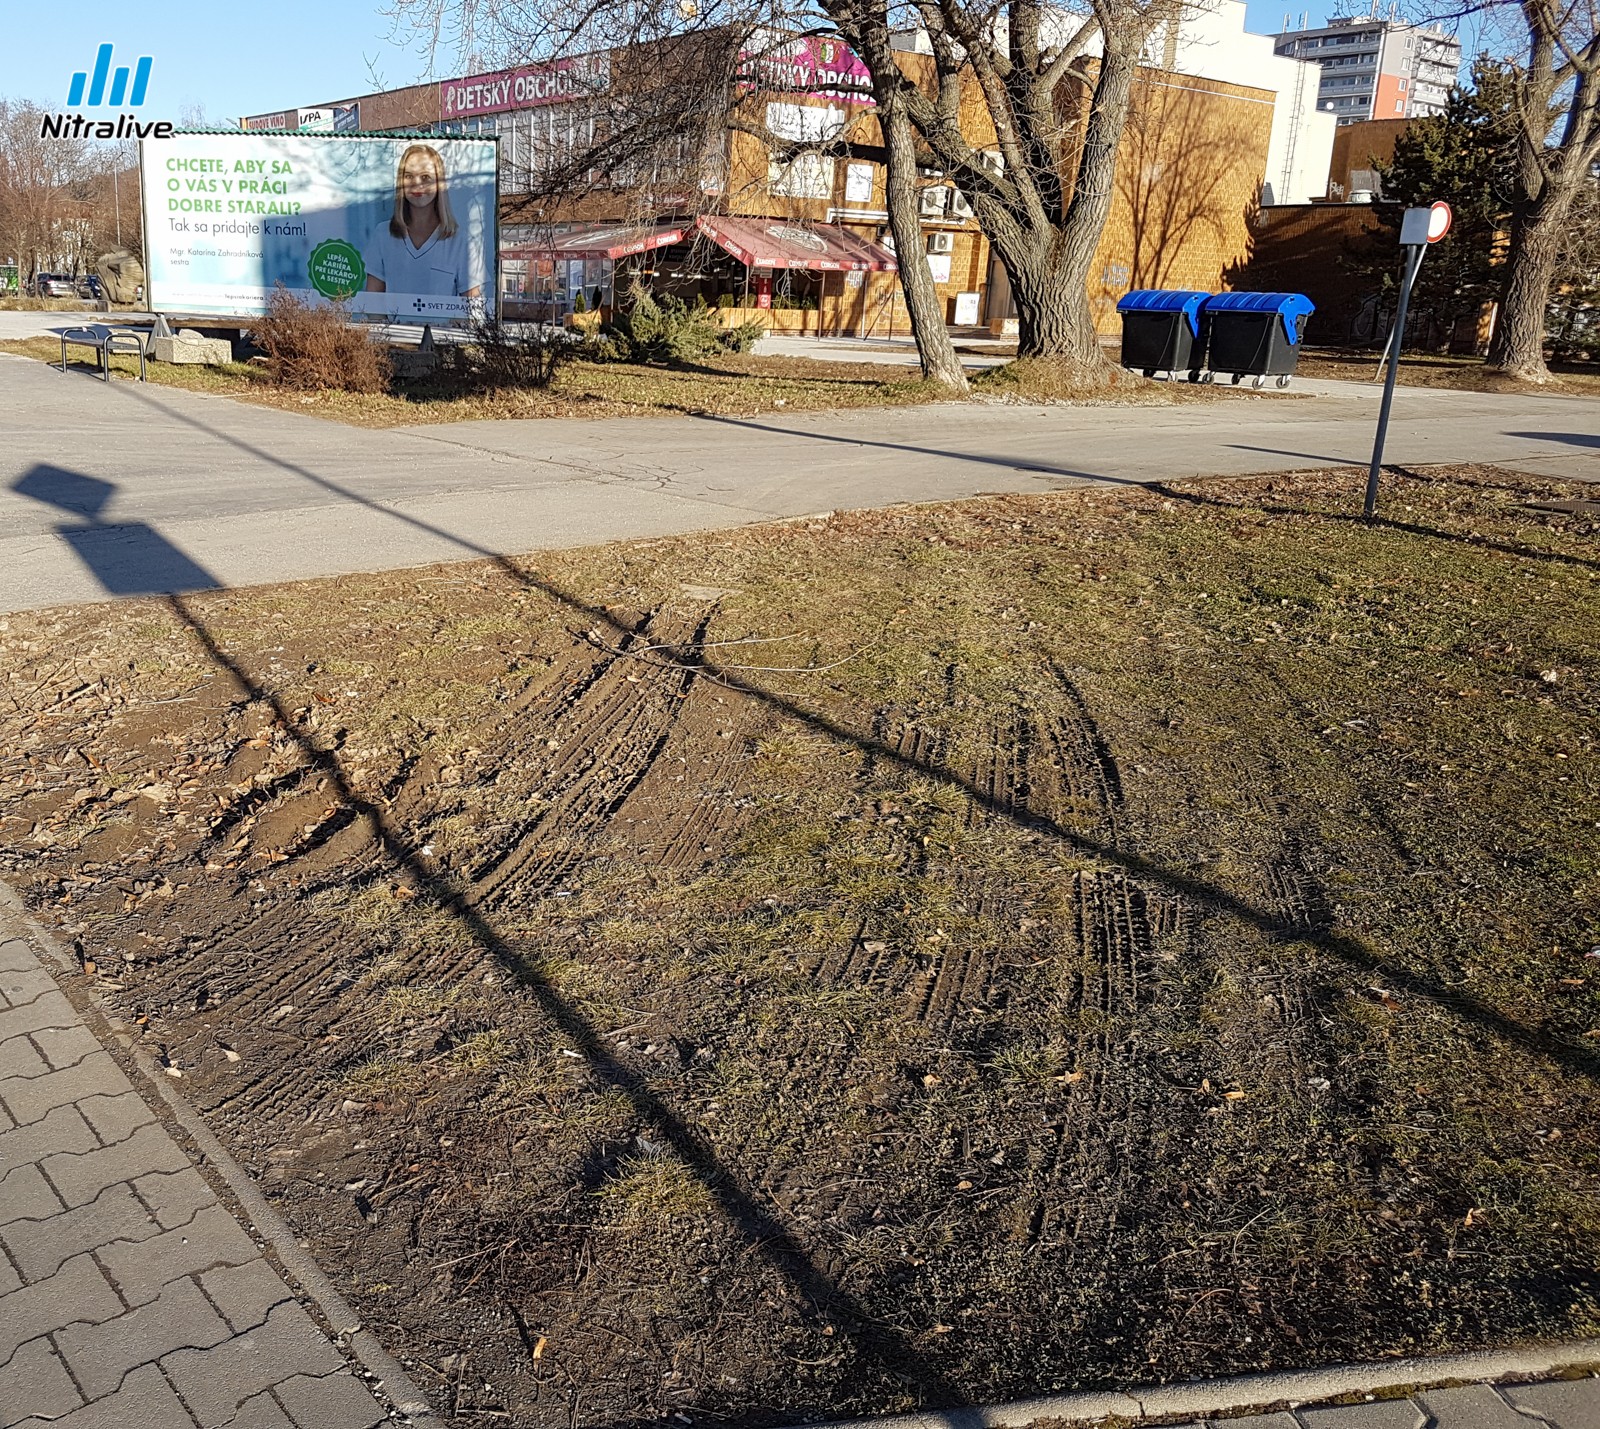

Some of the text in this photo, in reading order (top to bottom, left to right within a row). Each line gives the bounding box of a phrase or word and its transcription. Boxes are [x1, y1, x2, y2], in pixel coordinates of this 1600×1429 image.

[457, 74, 511, 111] DETSKÝ
[300, 111, 321, 125] ISPA
[166, 158, 293, 175] CHCETE, ABY SA
[167, 174, 287, 194] O VÁS V PRÁCI
[168, 198, 302, 216] DOBRE STARALI?
[168, 217, 307, 238] Tak sa pridajte k nám!
[169, 248, 185, 257] Mgr.
[188, 248, 216, 257] Katarína
[327, 253, 349, 264] LEPŠIA
[315, 265, 358, 280] PRE LEKÁROV
[323, 260, 352, 272] KARIÉRA
[327, 275, 351, 286] SESTRY
[428, 302, 469, 312] SVET ZDRAV
